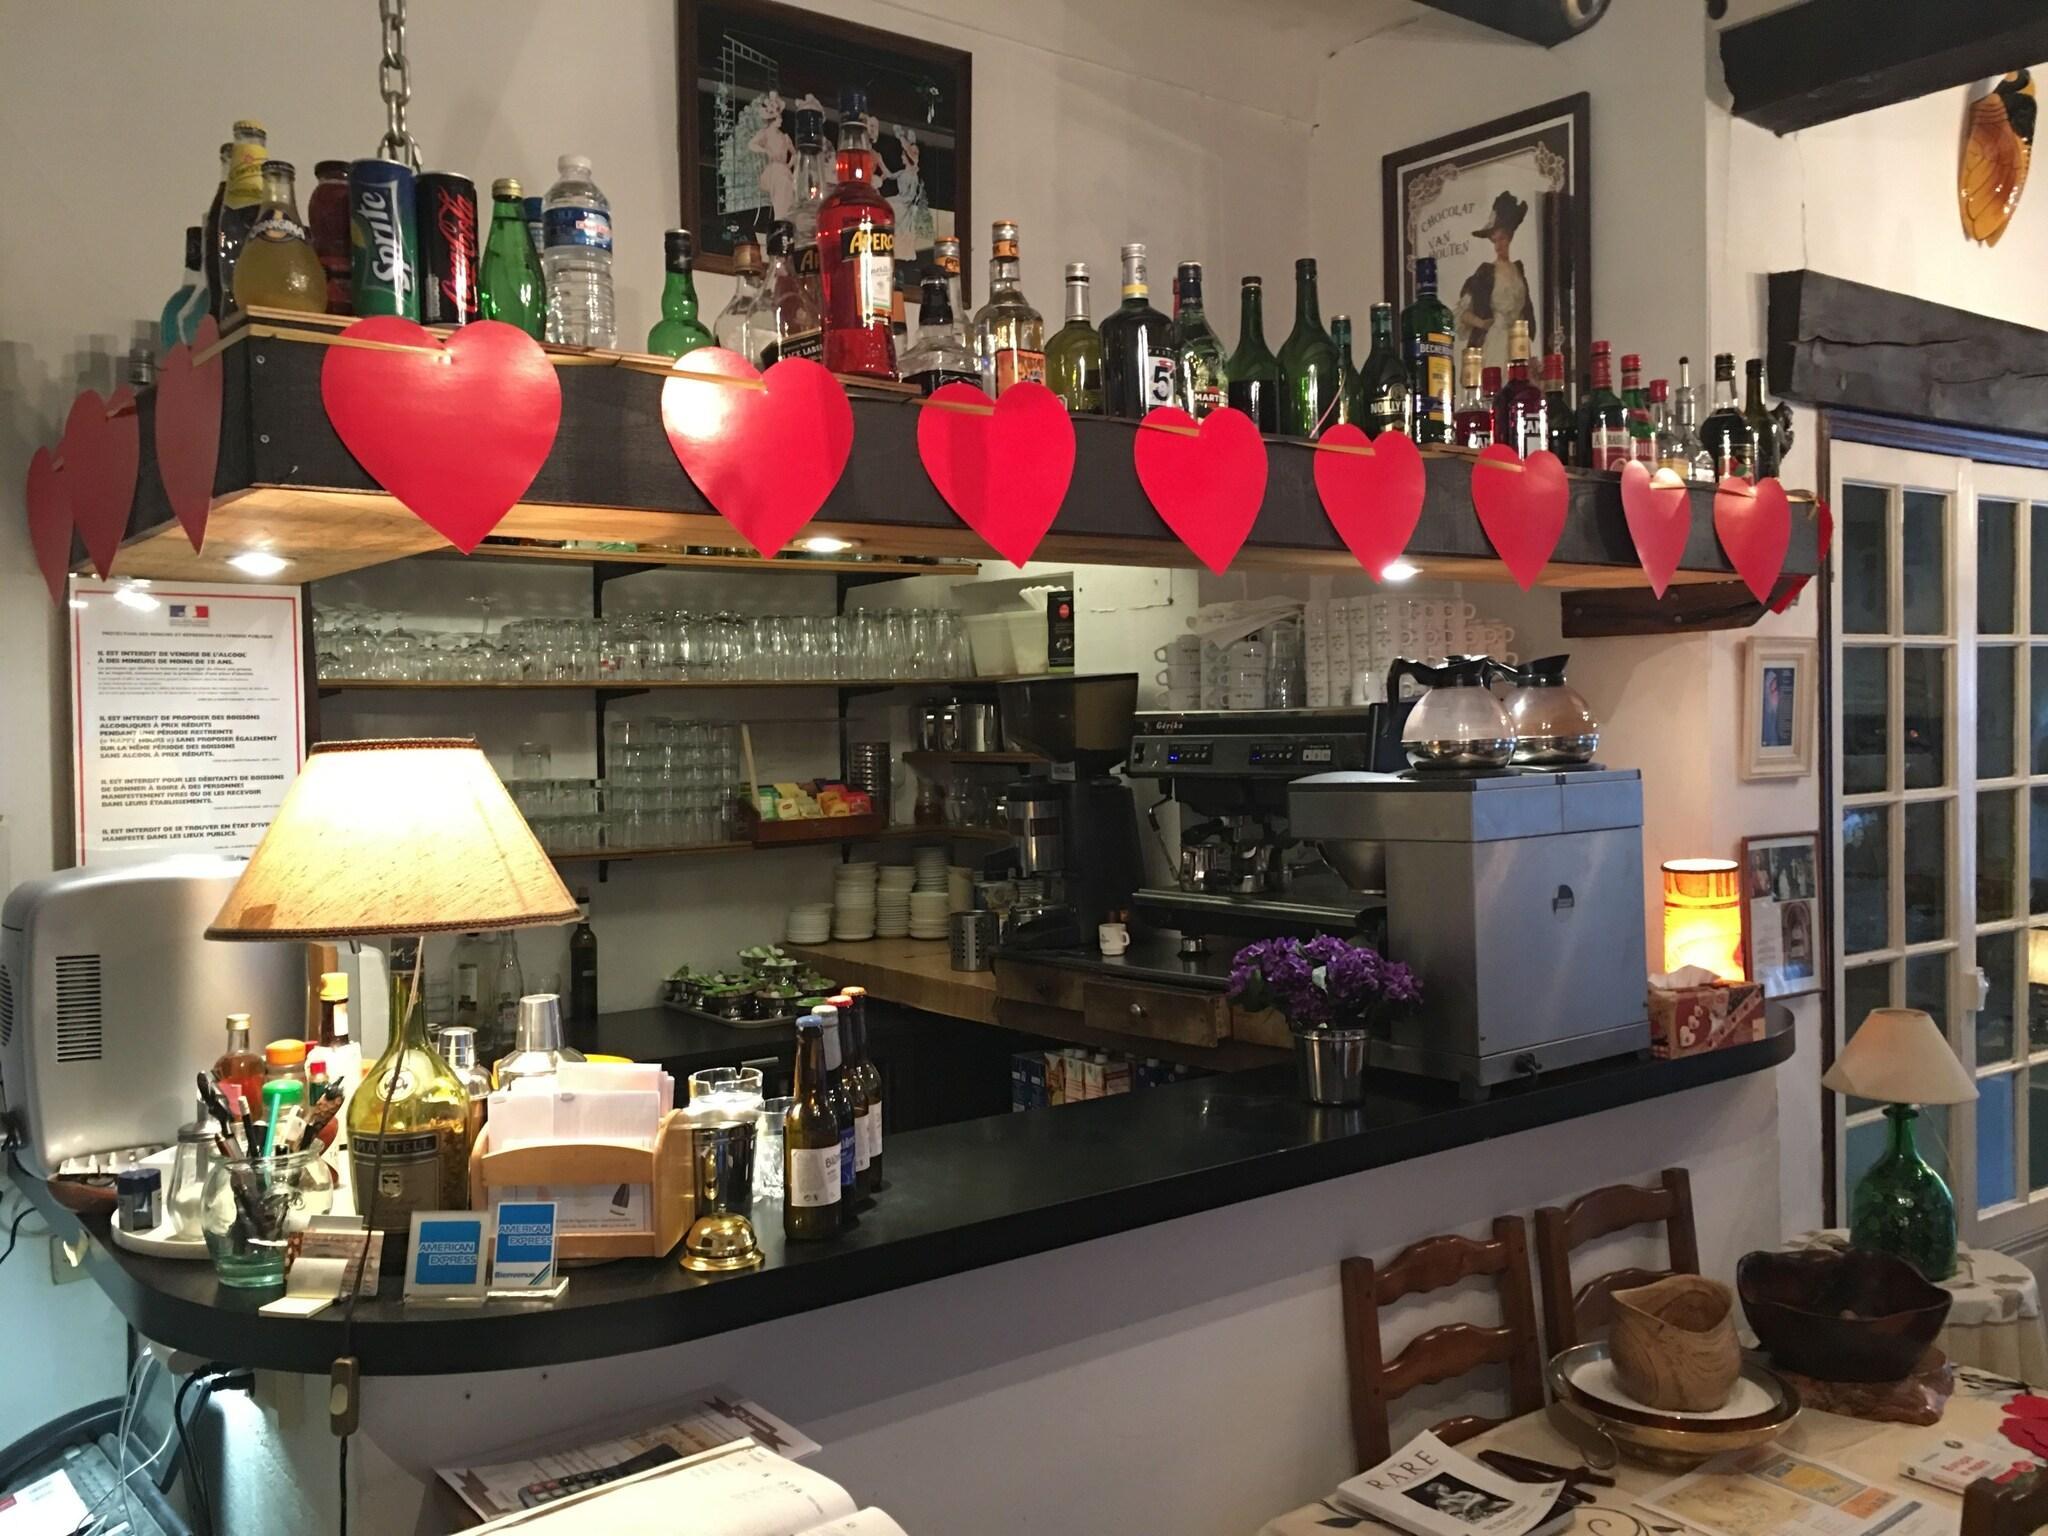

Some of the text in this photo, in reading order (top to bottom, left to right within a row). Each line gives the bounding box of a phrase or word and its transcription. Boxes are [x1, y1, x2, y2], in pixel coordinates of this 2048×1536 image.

[1421, 202, 1475, 232] CHOCOLAT
[359, 191, 413, 293] Sprite
[850, 230, 894, 253] APERO
[356, 1139, 432, 1153] MARTELL
[498, 1224, 550, 1234] AMERICAN
[419, 1242, 475, 1253] AMERICAN
[508, 1236, 553, 1246] EXPRESS
[429, 1254, 478, 1265] EXPRESS
[1366, 1450, 1439, 1490] RARE
